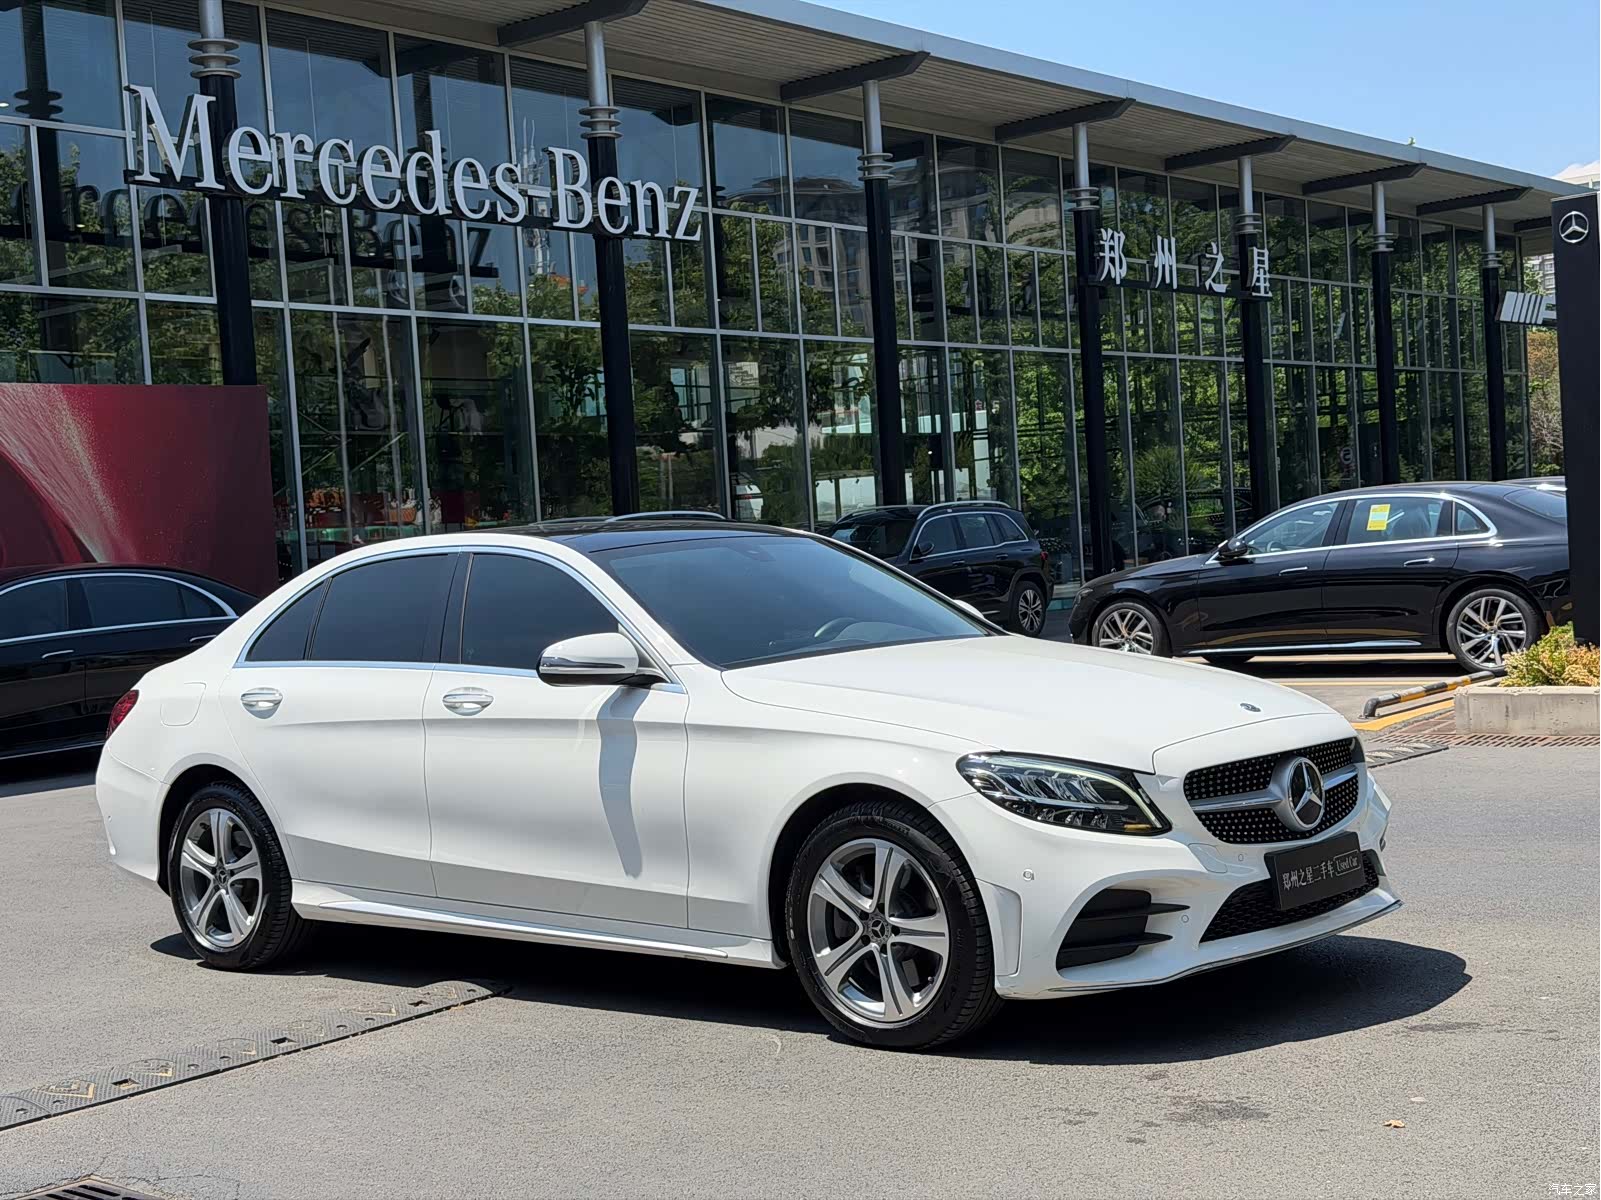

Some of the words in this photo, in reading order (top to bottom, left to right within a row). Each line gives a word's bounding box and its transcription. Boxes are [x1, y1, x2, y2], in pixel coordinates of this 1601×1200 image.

[124, 84, 702, 242] Mercedes-Benz
[1099, 227, 1273, 298] 郑州之星
[1282, 860, 1335, 891] 郑州之星二手车
[1336, 857, 1349, 872] Used
[1349, 855, 1358, 868] Car
